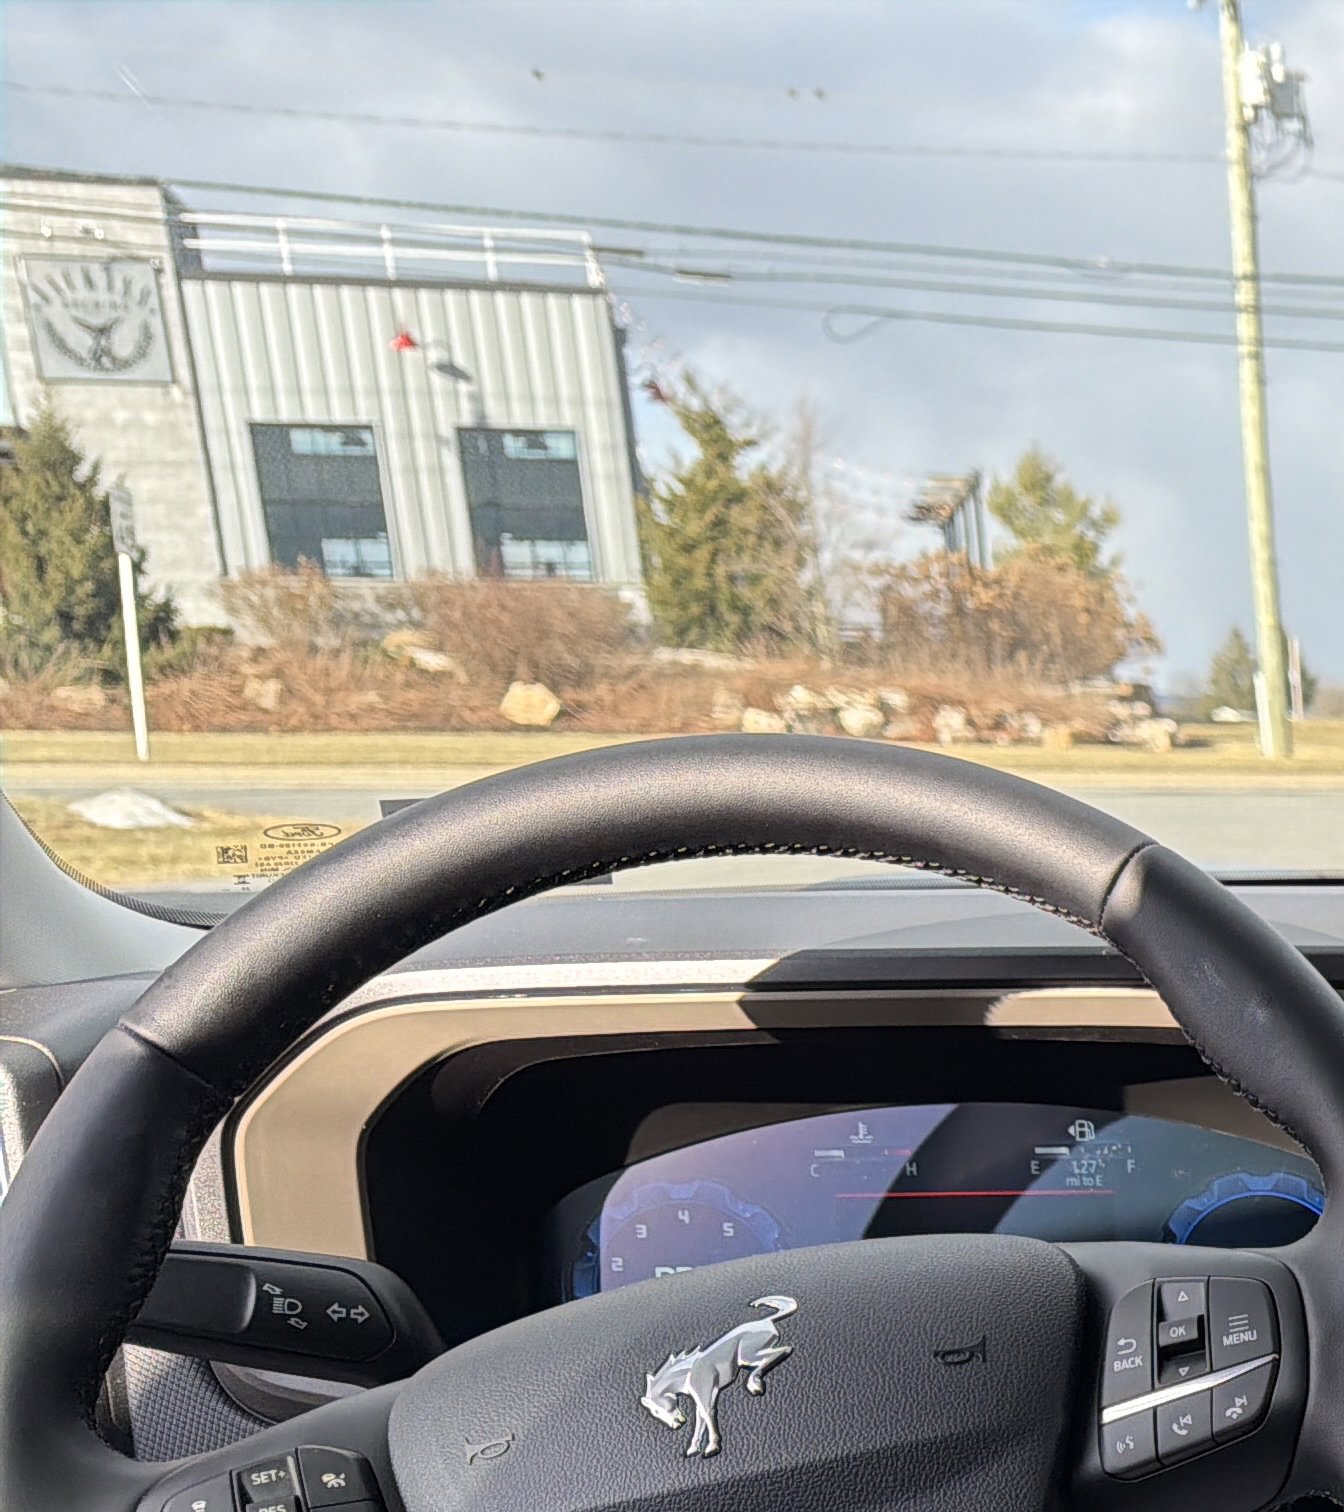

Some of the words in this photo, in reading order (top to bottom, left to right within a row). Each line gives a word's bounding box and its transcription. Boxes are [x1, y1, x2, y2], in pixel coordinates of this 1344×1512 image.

[906, 1162, 918, 1177] H
[1030, 1160, 1040, 1175] E
[1126, 1159, 1136, 1174] F
[1065, 1175, 1081, 1187] mi
[1083, 1176, 1094, 1187] to
[677, 1209, 690, 1225] 4
[635, 1224, 648, 1239] 3
[722, 1222, 735, 1237] 5
[611, 1256, 624, 1272] 2
[1169, 1325, 1187, 1338] OK
[1222, 1330, 1258, 1347] MENU
[1113, 1355, 1144, 1372] BACK
